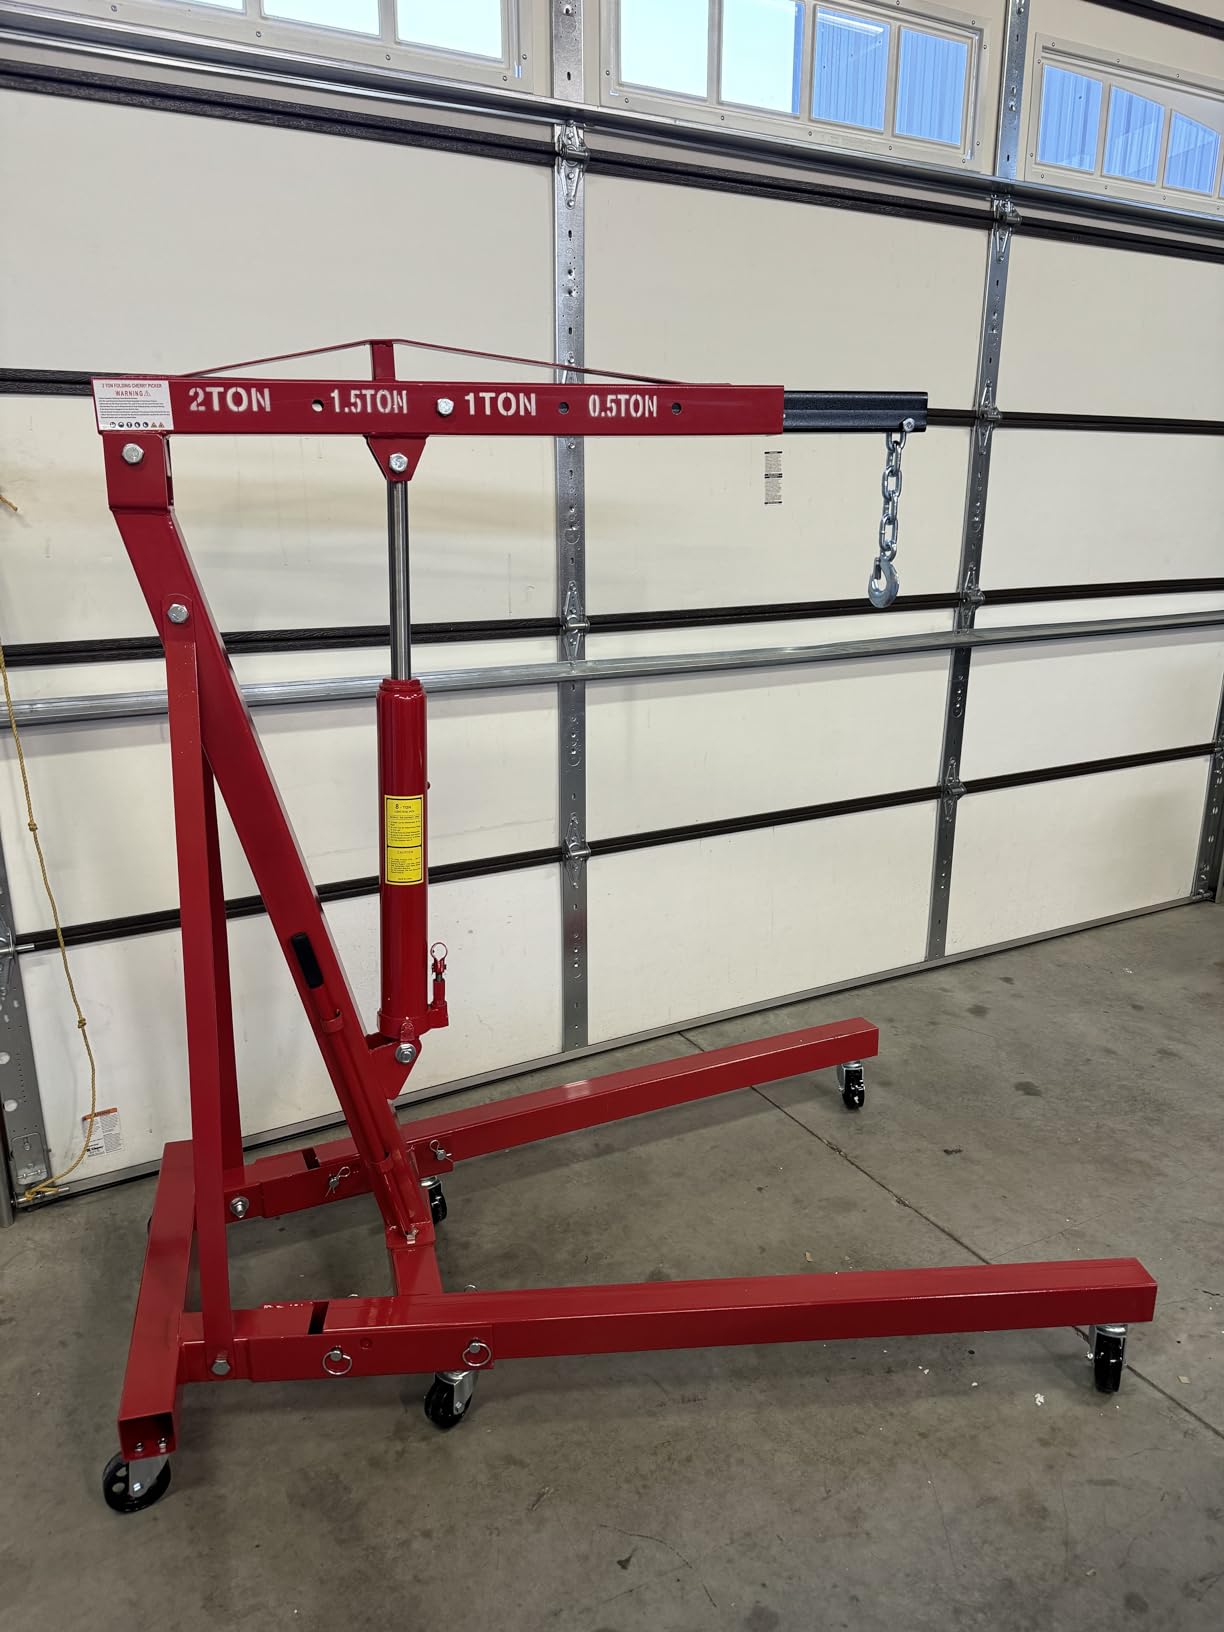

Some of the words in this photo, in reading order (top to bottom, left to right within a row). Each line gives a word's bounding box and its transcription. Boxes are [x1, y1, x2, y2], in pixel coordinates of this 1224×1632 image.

[188, 387, 271, 412] 2TON
[330, 389, 408, 414] 1.5TON
[464, 392, 537, 416] 1TON
[588, 394, 658, 418] 0.5TON
